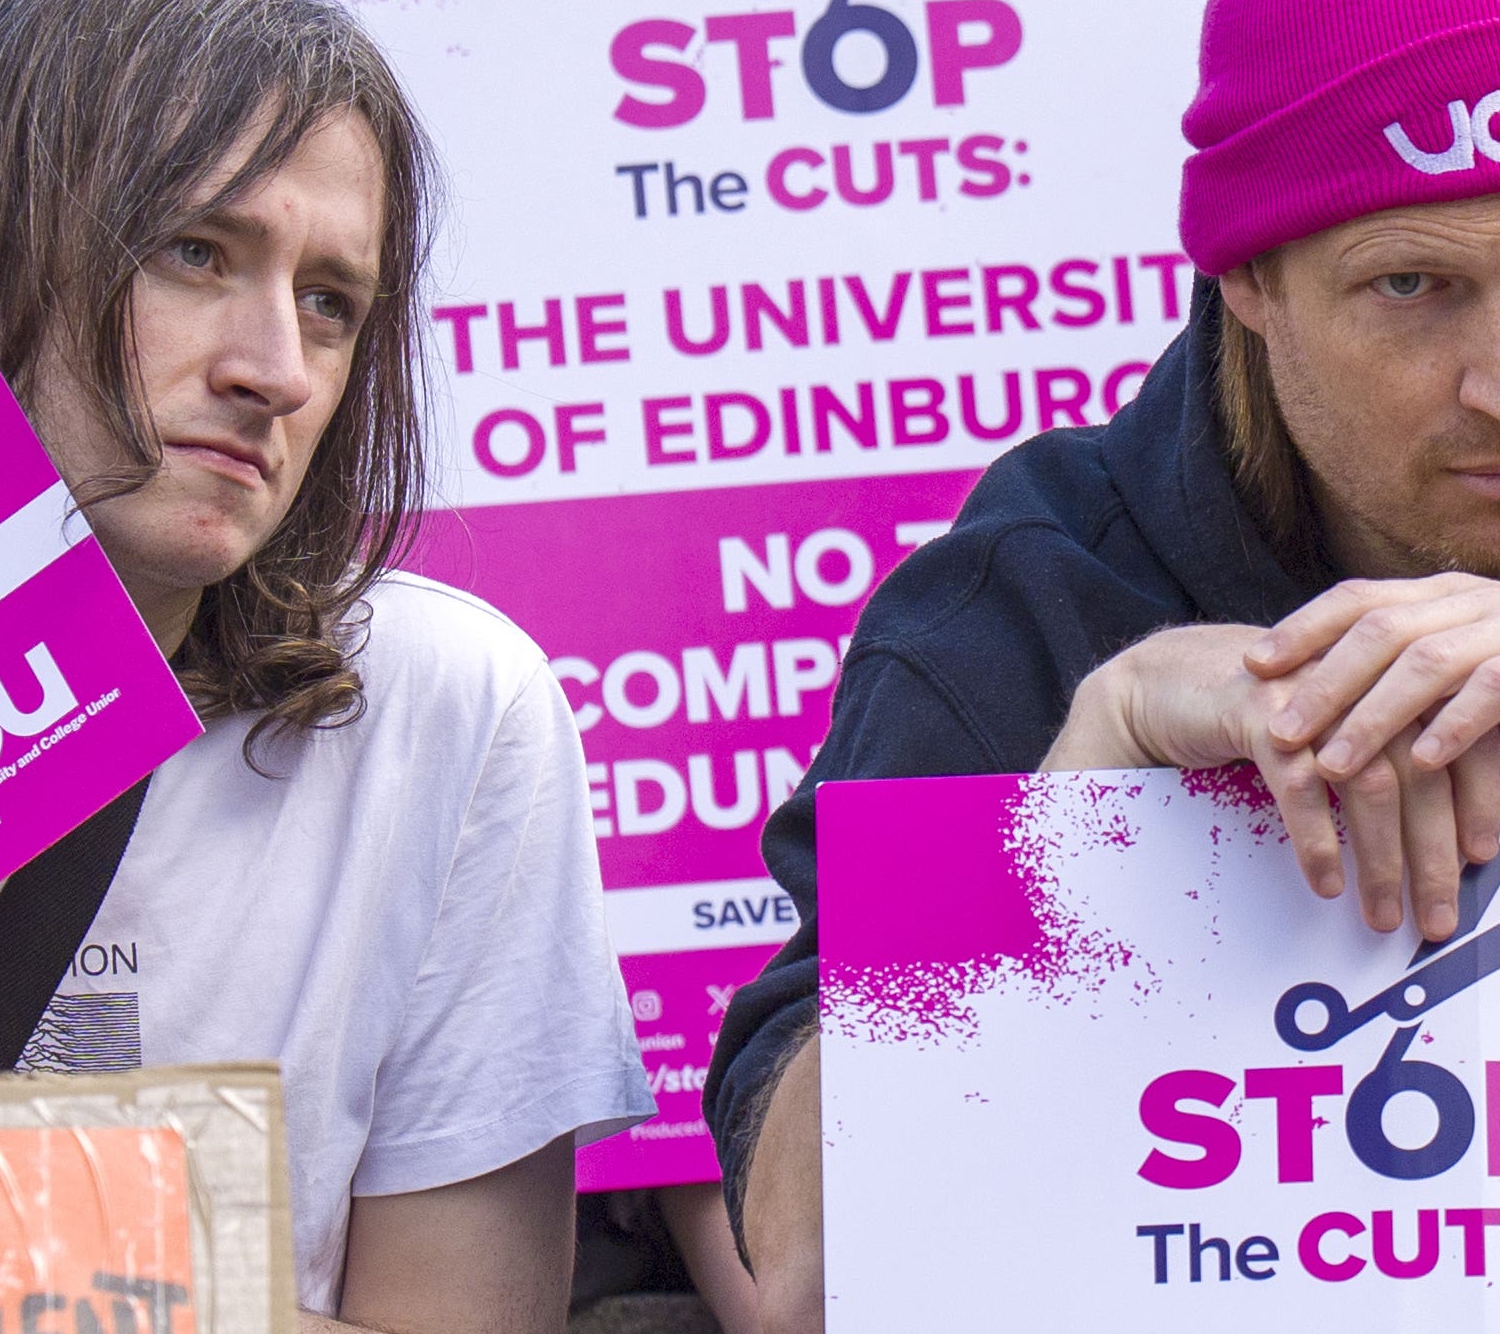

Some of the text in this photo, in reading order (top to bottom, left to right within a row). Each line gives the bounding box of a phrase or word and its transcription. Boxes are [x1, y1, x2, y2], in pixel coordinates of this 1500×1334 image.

[616, 135, 1031, 219] The CUTS:
[433, 251, 1193, 374] THE UNIVERSIT
[473, 360, 1151, 478] OF EDINBUR
[718, 528, 873, 613] NO
[17, 744, 41, 768] and
[40, 713, 87, 750] College
[693, 894, 794, 930] SAVE
[1136, 1222, 1280, 1284] The
